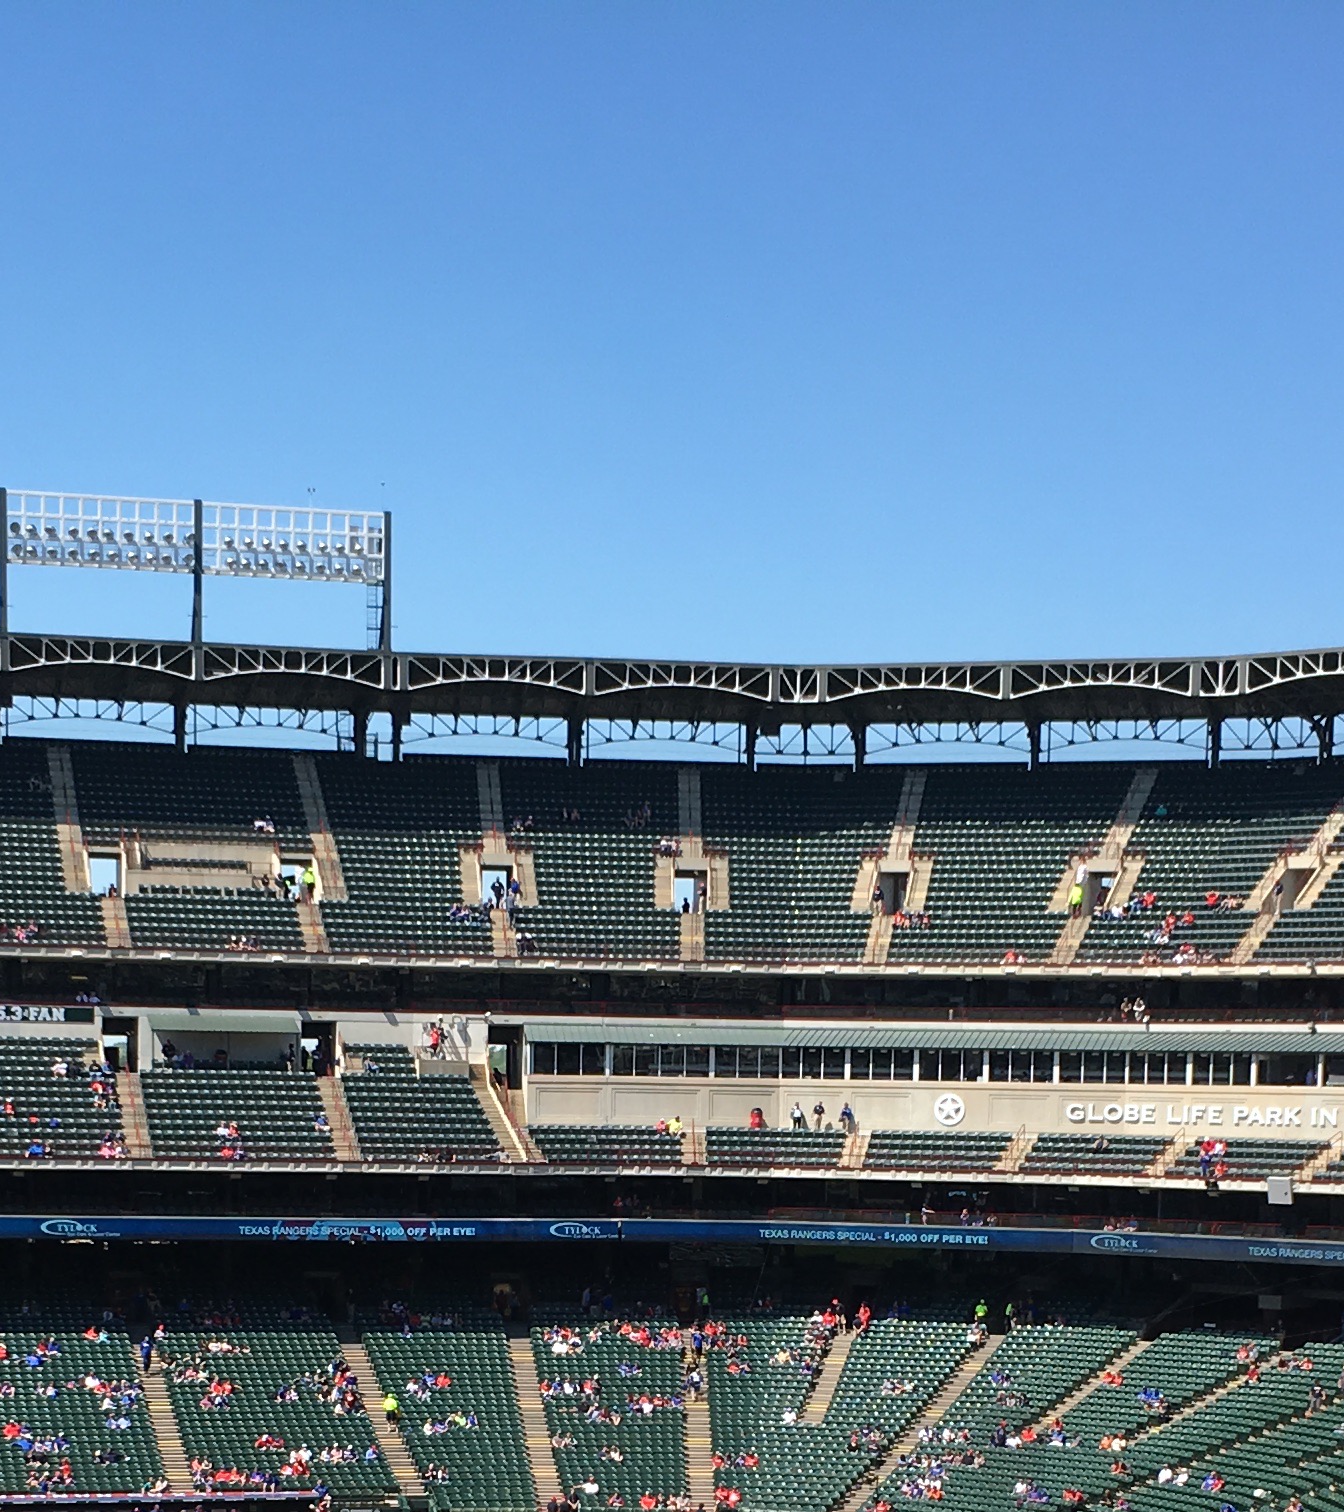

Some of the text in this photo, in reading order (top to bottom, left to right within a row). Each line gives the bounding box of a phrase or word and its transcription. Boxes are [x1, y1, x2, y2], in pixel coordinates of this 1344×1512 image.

[28, 1007, 66, 1021] FAN
[1066, 1103, 1156, 1124] GLOBE
[1166, 1105, 1224, 1125] LIFE
[1233, 1106, 1302, 1127] PARK
[1310, 1108, 1339, 1128] IN
[239, 1225, 270, 1235] TEXAS
[272, 1226, 318, 1236] RANGERS
[321, 1226, 362, 1236] SPECIAL
[370, 1226, 404, 1238] $1,000
[407, 1227, 426, 1236] OFF
[430, 1227, 450, 1236] PER
[453, 1228, 475, 1236] EYE!
[759, 1229, 789, 1239] TEXAS
[791, 1230, 835, 1240] RANGERS
[837, 1231, 876, 1241] SPECIAL
[884, 1232, 918, 1244] $1,000
[920, 1233, 939, 1243] OFF
[942, 1235, 963, 1244] PER
[965, 1235, 988, 1245] EYE!
[1248, 1246, 1277, 1257] TEXAS
[1279, 1248, 1323, 1259] RANGERS
